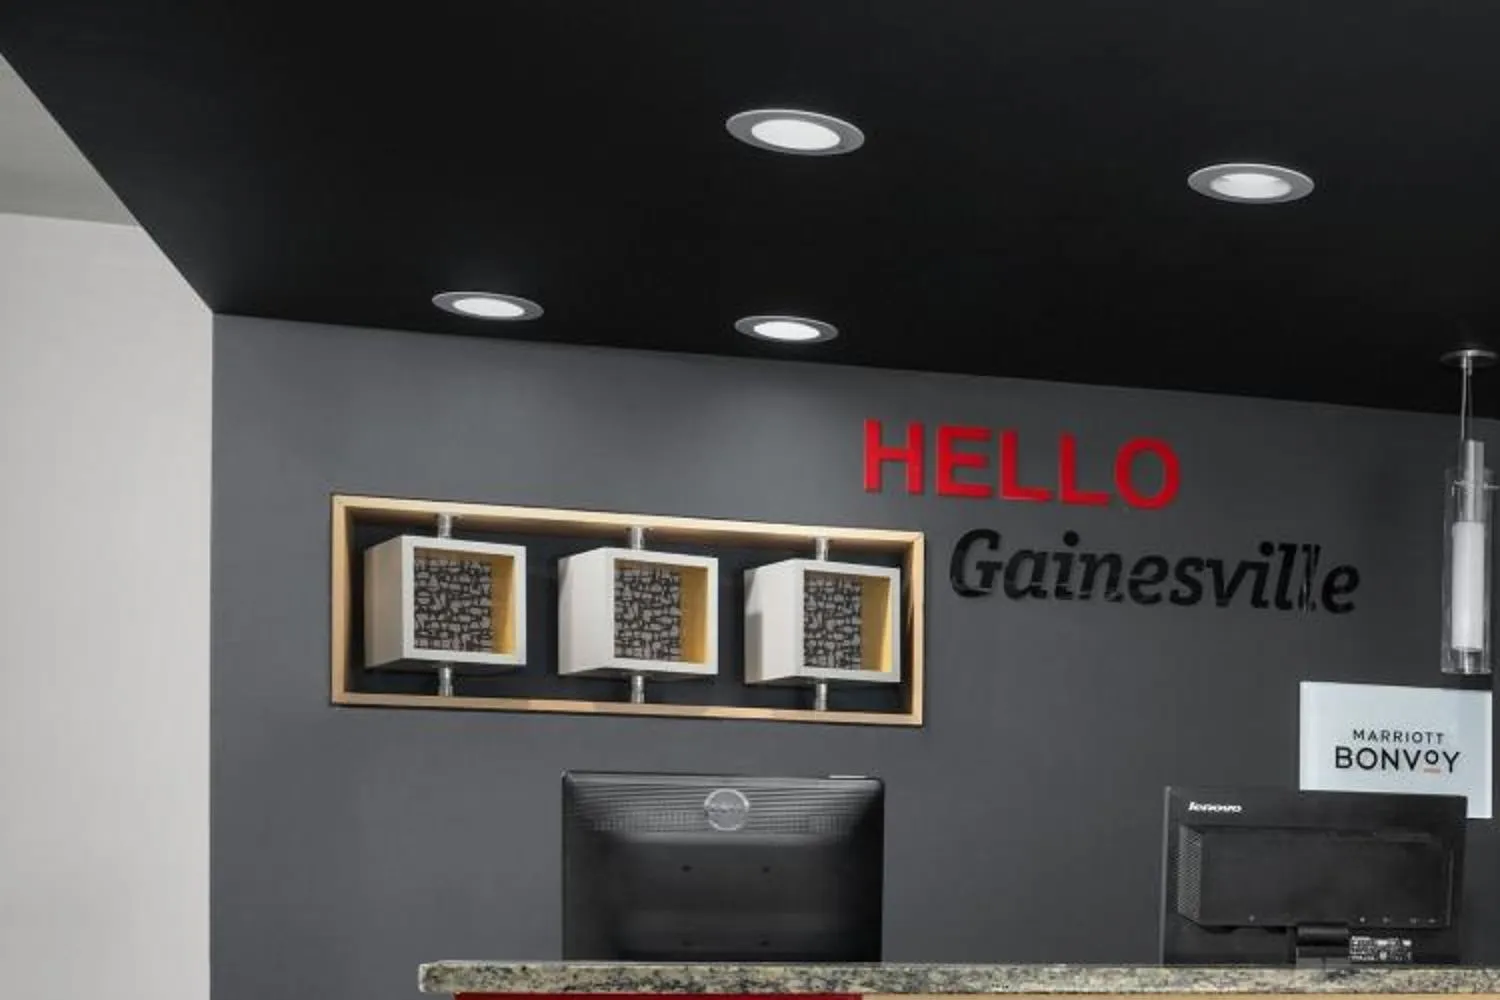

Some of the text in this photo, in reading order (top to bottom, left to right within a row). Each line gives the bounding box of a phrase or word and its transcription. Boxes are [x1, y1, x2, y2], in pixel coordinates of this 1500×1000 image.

[863, 418, 1181, 510] HELLO
[948, 528, 1361, 615] Gainesville
[1352, 729, 1445, 745] MARRIOTT
[1335, 746, 1461, 773] BONVOY
[1188, 801, 1243, 813] lenovo
